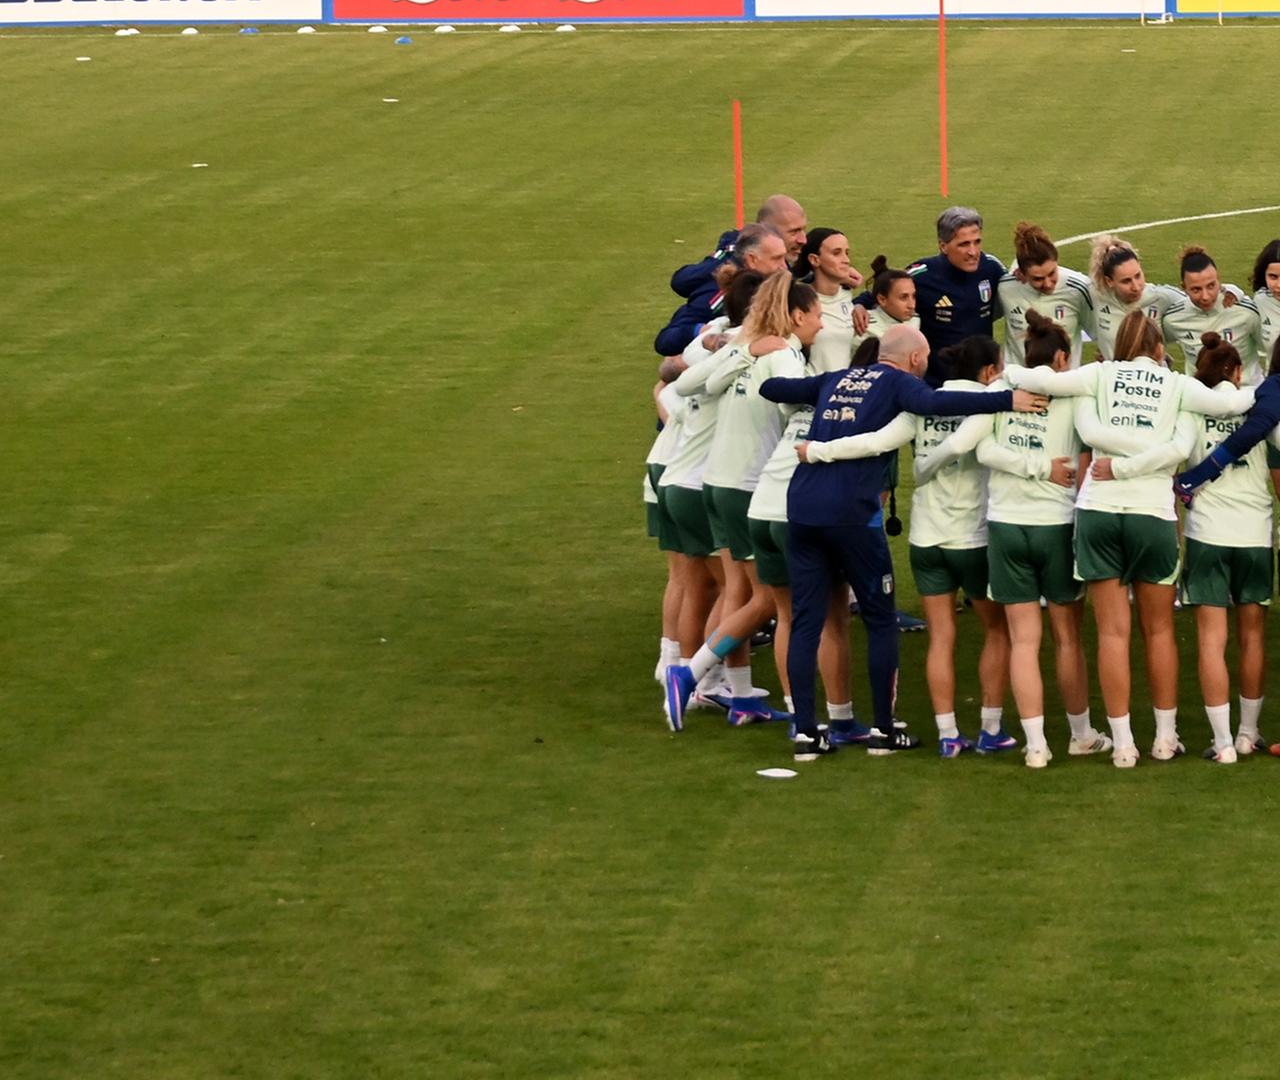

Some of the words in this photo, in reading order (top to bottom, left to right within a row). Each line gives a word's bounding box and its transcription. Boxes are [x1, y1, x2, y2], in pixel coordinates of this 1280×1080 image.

[1136, 369, 1164, 385] TIM
[1113, 381, 1162, 399] Poste
[924, 417, 960, 433] Post
[1110, 413, 1134, 427] eni
[1205, 418, 1241, 433] Post
[1008, 433, 1029, 448] eni
